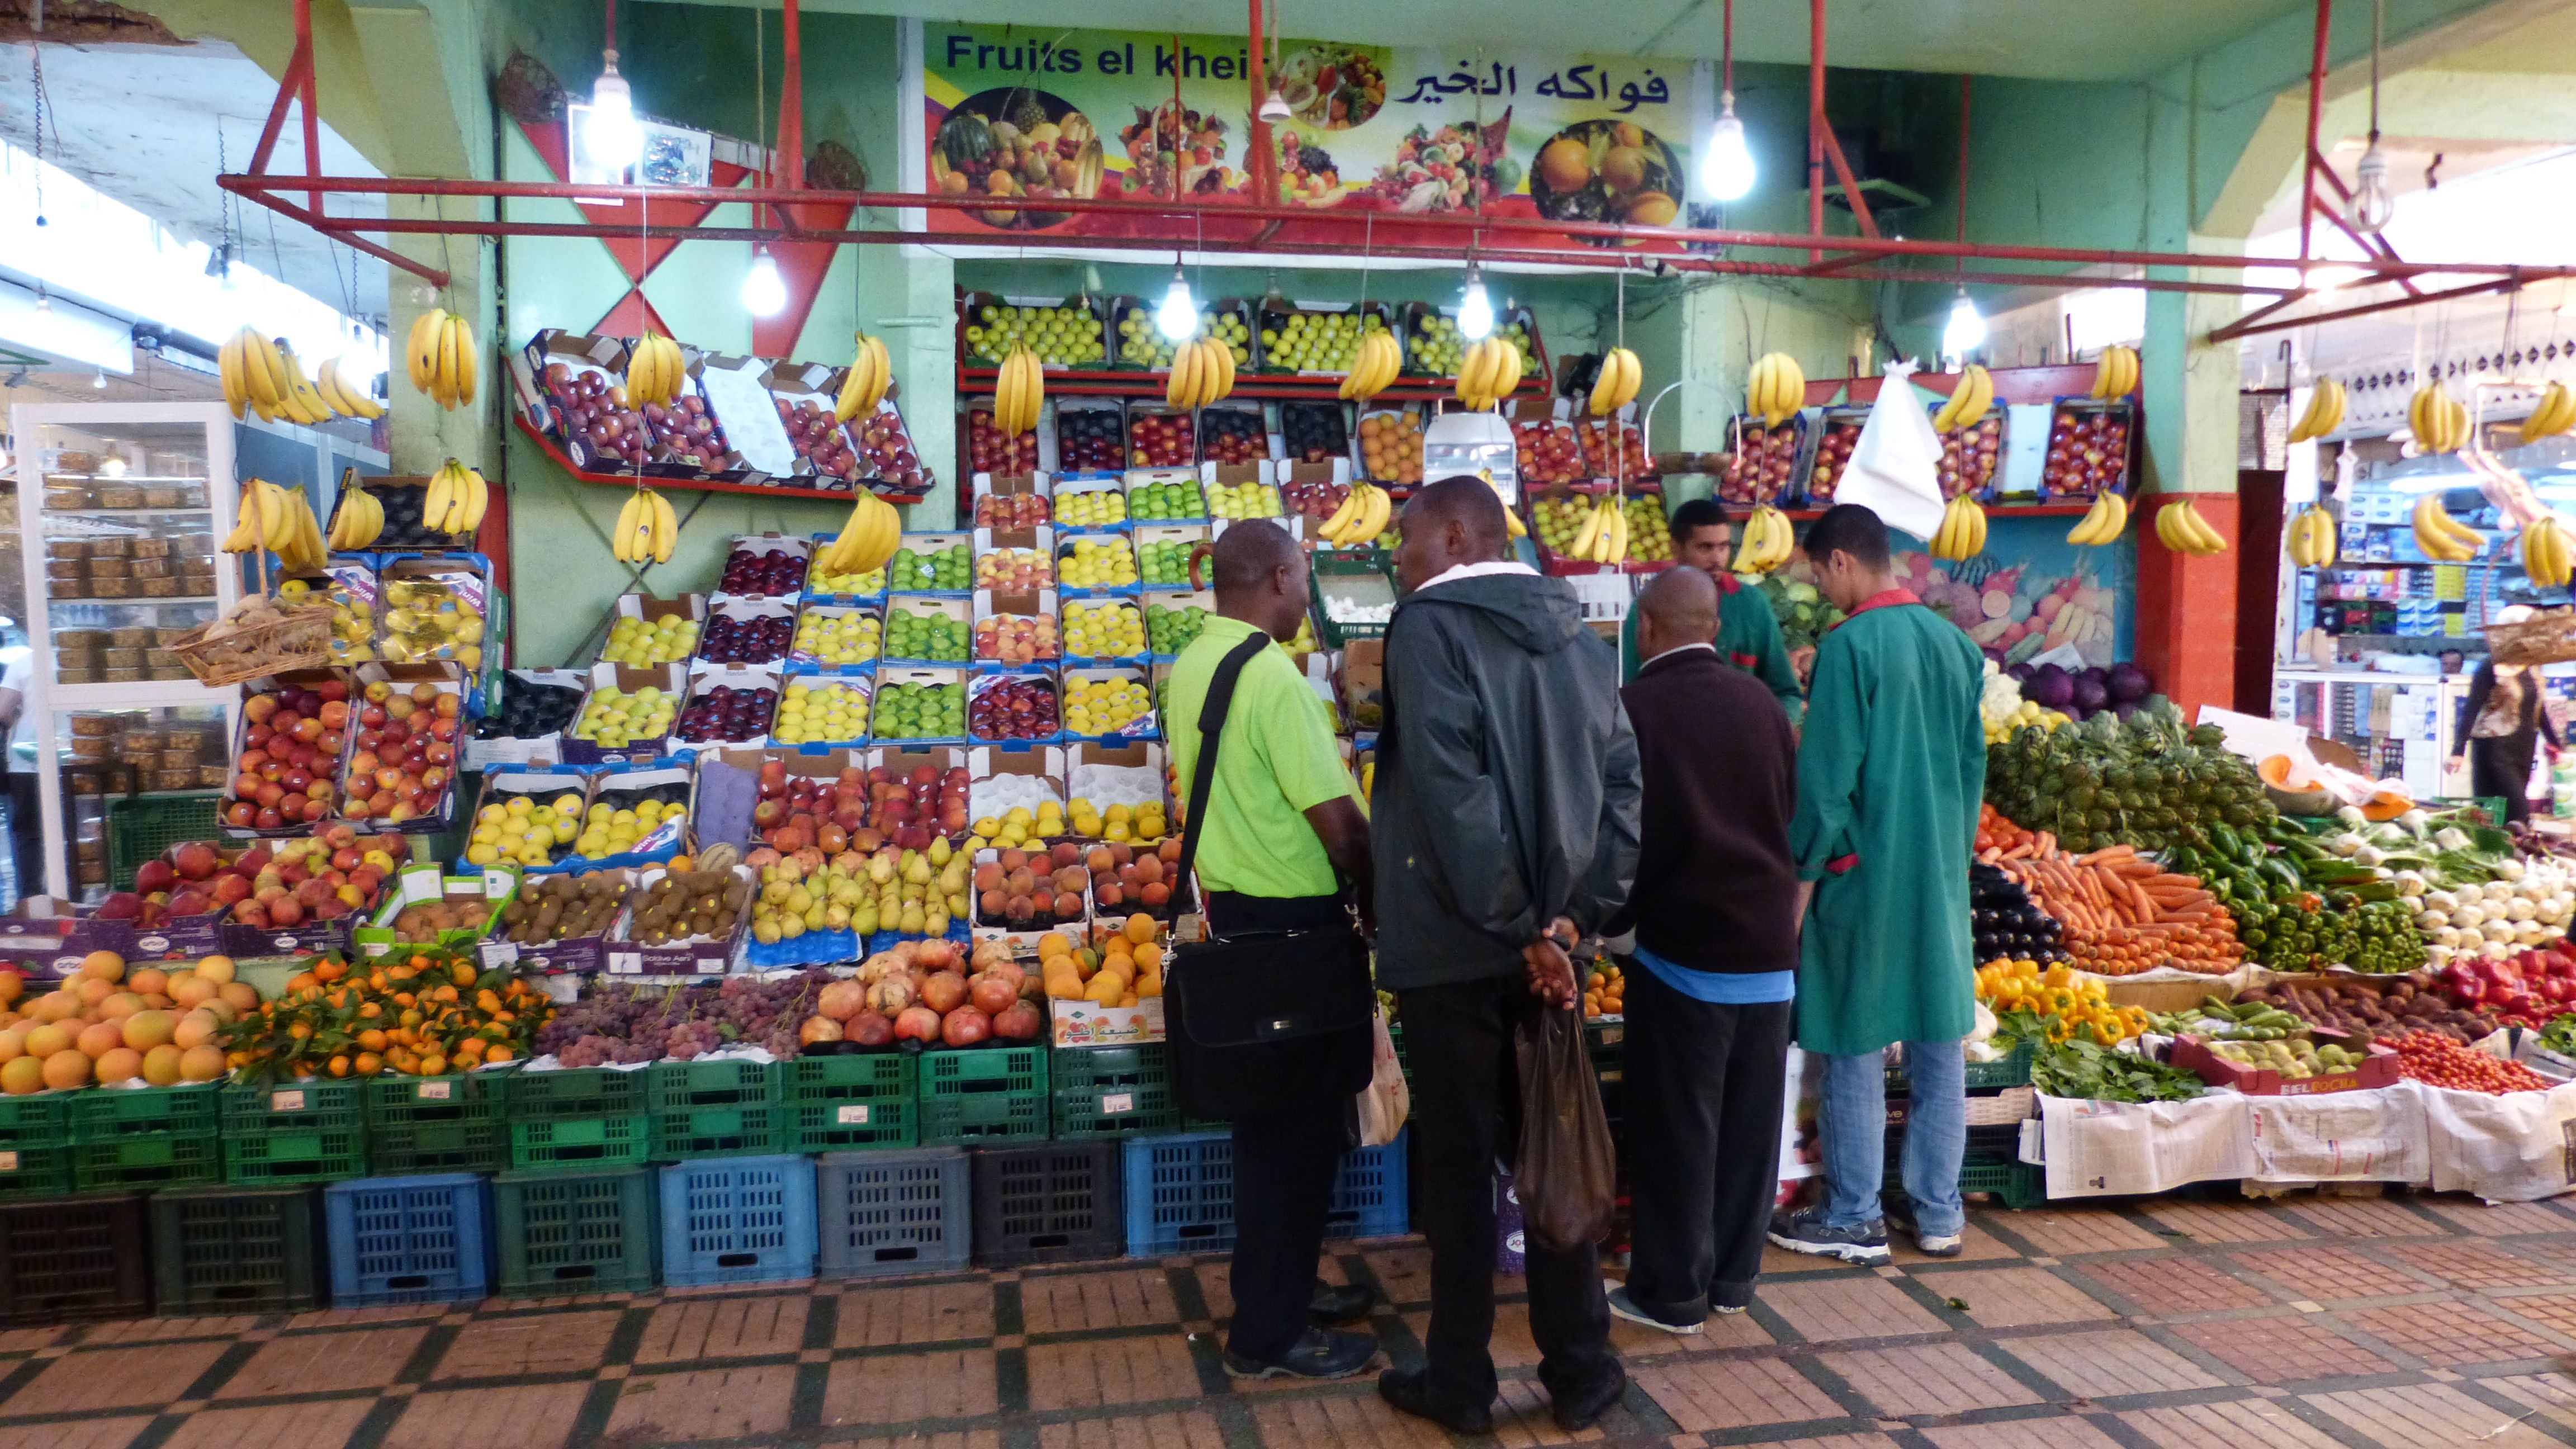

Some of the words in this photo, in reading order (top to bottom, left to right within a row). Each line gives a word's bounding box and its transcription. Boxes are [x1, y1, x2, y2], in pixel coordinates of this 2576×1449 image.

[946, 35, 1082, 74] Fruits
[1097, 43, 1134, 75] el
[1155, 45, 1270, 80] khei
[1393, 59, 1516, 103] الخير
[1535, 64, 1670, 113] فواكه
